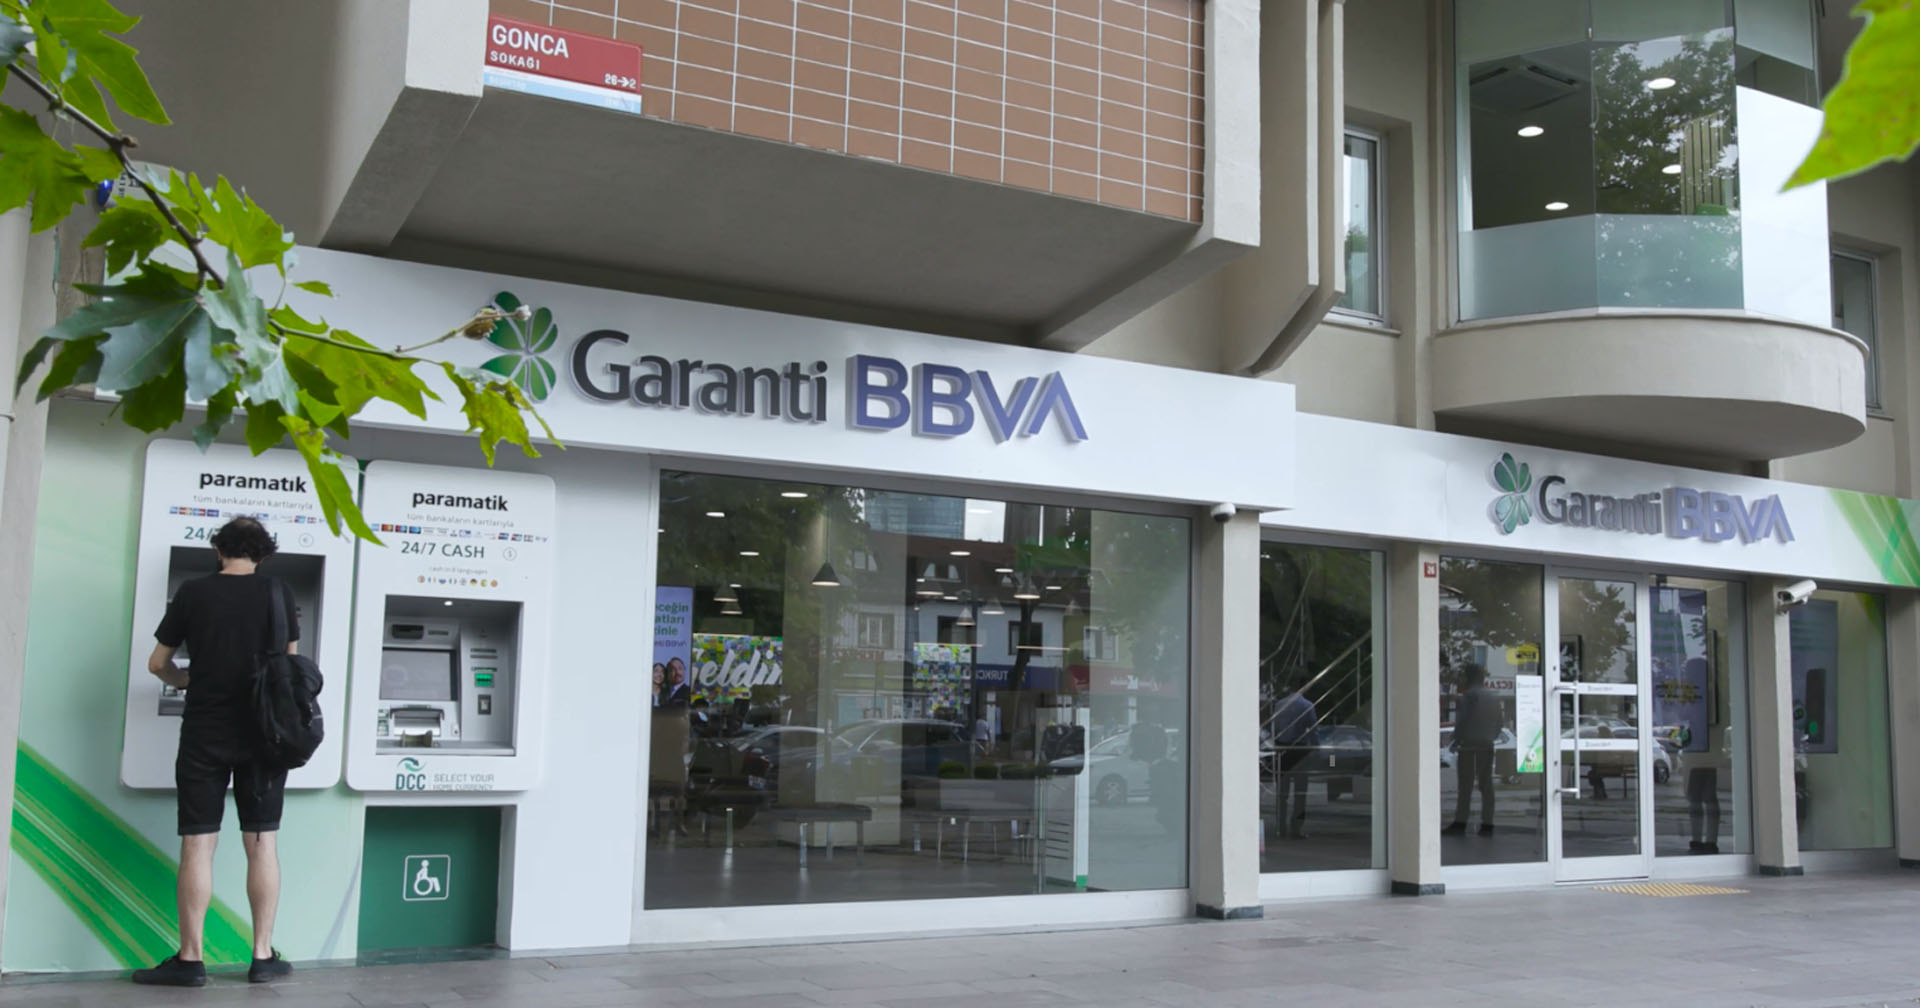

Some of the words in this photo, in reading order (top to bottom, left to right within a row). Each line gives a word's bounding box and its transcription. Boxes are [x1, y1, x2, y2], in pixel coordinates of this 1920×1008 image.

[492, 24, 569, 59] GONCA
[490, 50, 540, 70] SOKAĞI
[569, 329, 828, 424] Garanti
[845, 353, 1089, 444] BBVA
[193, 495, 213, 504] tüm
[412, 492, 508, 512] paramatik
[407, 512, 425, 521] tüm
[1536, 475, 1663, 534] Garanti
[1664, 486, 1796, 545] BBVA
[401, 541, 436, 556] 24/7
[441, 543, 485, 559] CASH
[395, 773, 426, 790] DCC
[433, 774, 467, 782] SELECT
[469, 774, 494, 782] YOUR
